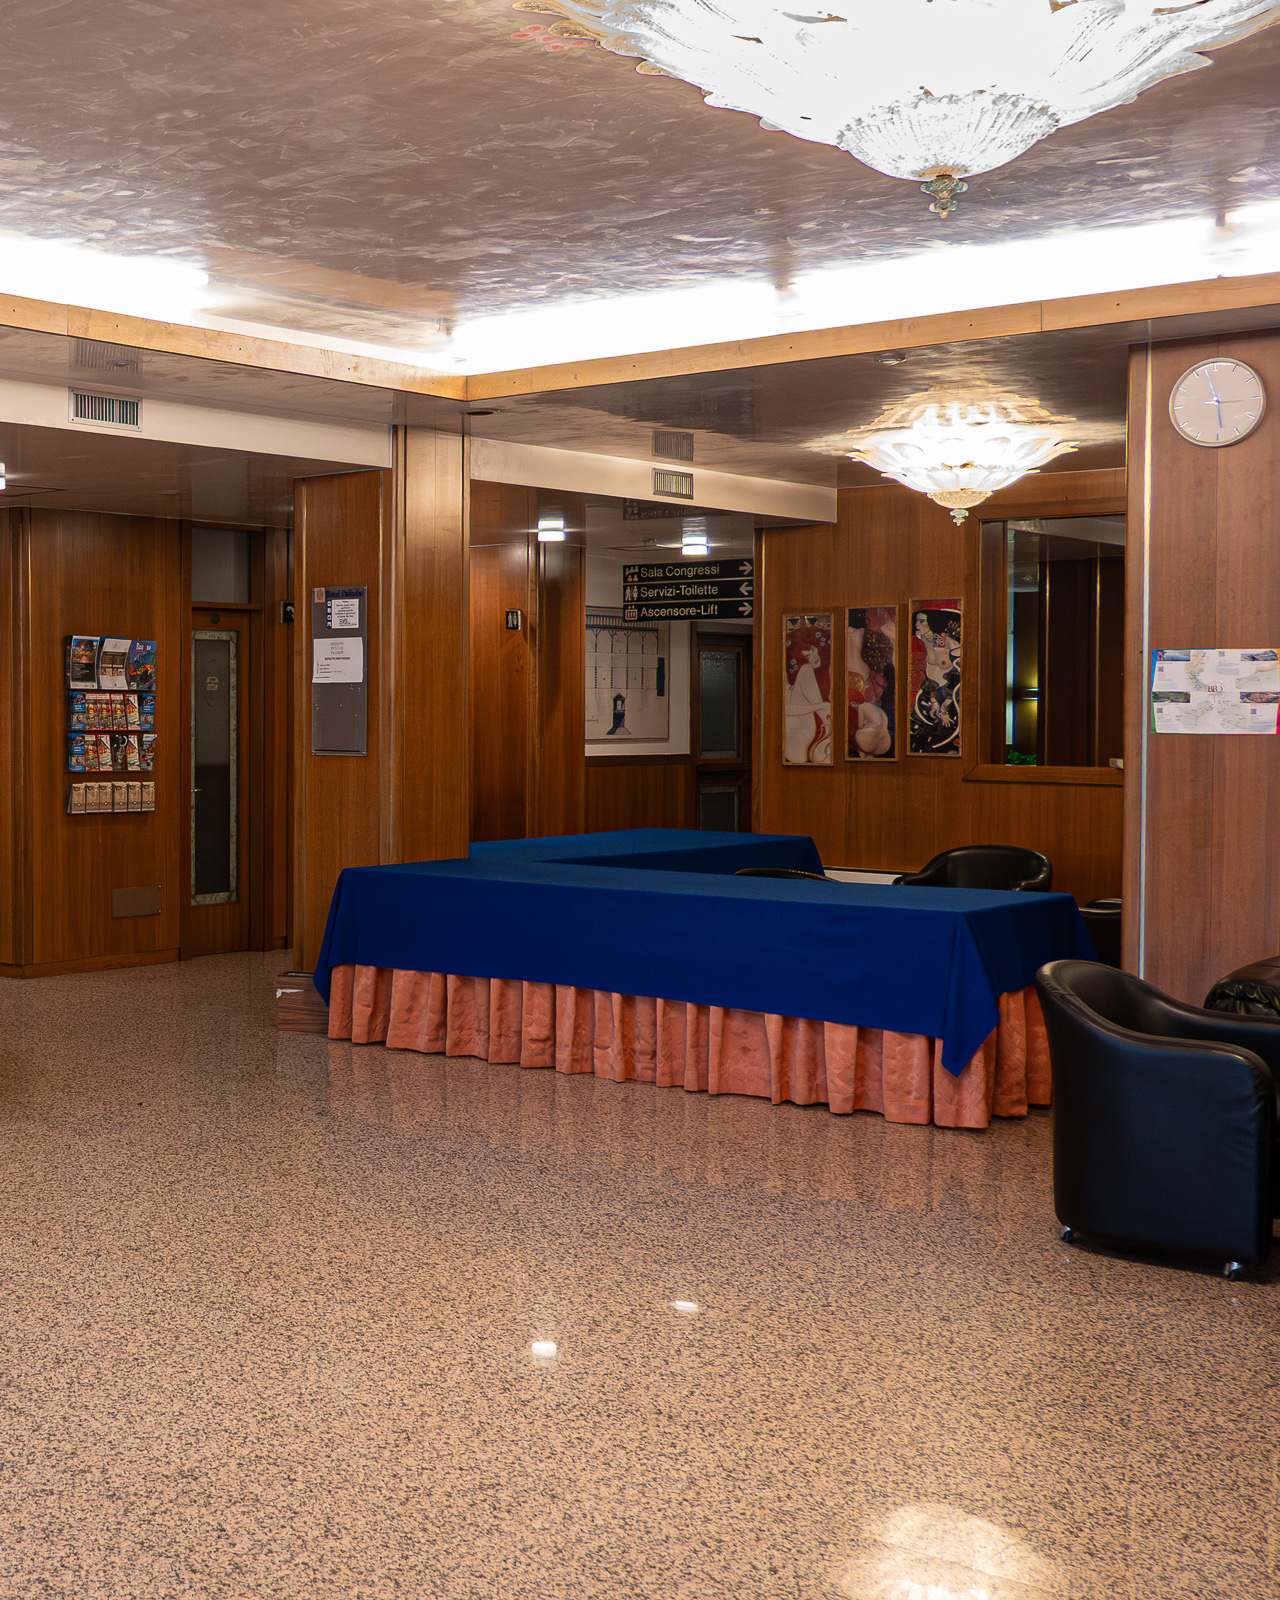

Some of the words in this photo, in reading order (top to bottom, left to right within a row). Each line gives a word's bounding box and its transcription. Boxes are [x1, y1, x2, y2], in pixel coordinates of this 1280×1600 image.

[640, 567, 663, 578] Sala
[665, 564, 719, 577] Congressi
[640, 585, 718, 598] Servizi-Toilette
[640, 604, 718, 617] Ascensore-Lift
